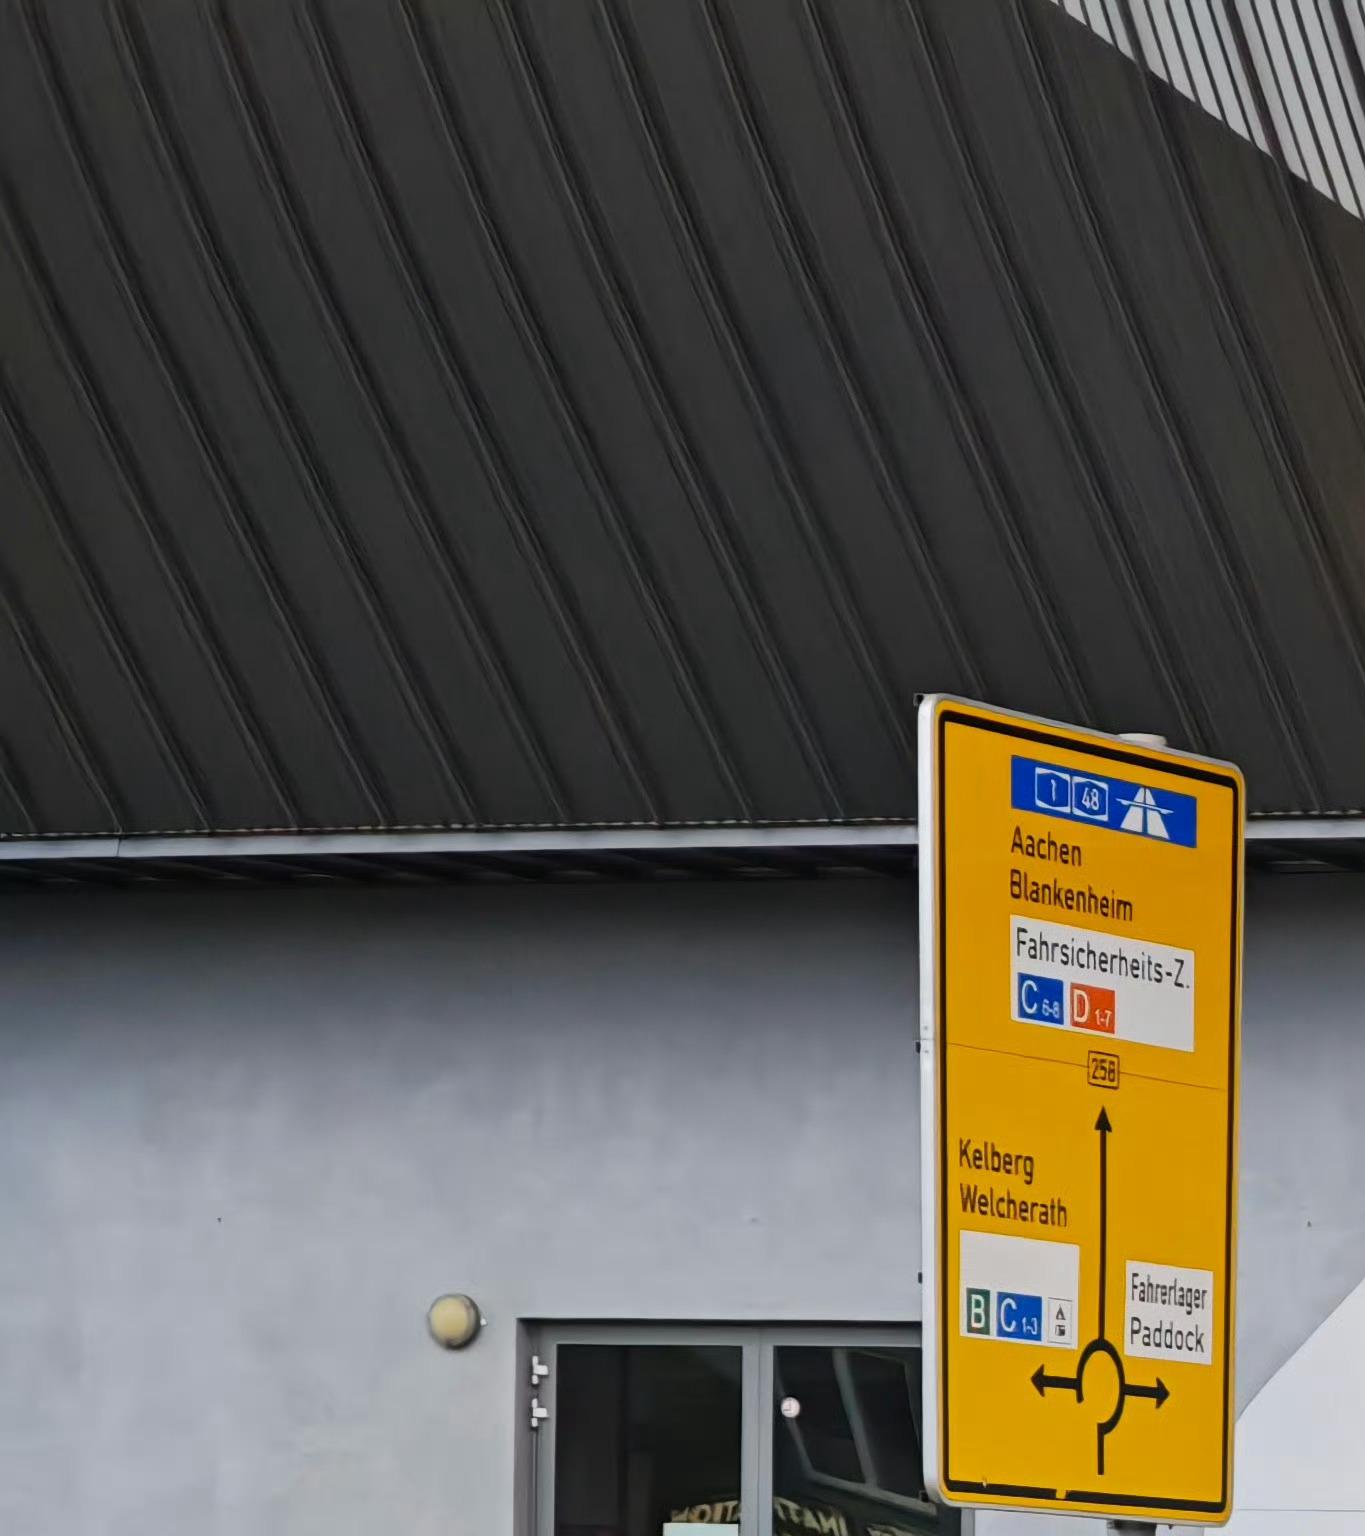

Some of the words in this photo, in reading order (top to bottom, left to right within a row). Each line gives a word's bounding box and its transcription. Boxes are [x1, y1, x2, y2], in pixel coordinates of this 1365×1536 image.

[1081, 787, 1100, 811] 48
[1011, 825, 1082, 867] Aachen
[1010, 869, 1133, 922] Blankenheim
[1016, 927, 1190, 989] Fahrsicherheits-Z.
[1092, 1057, 1116, 1082] 258
[959, 1138, 1035, 1185] Kelberg
[959, 1183, 1068, 1228] Welcherath
[970, 1294, 986, 1328] B
[1131, 1272, 1208, 1315] Fahrerlager
[1130, 1317, 1205, 1354] Paddock
